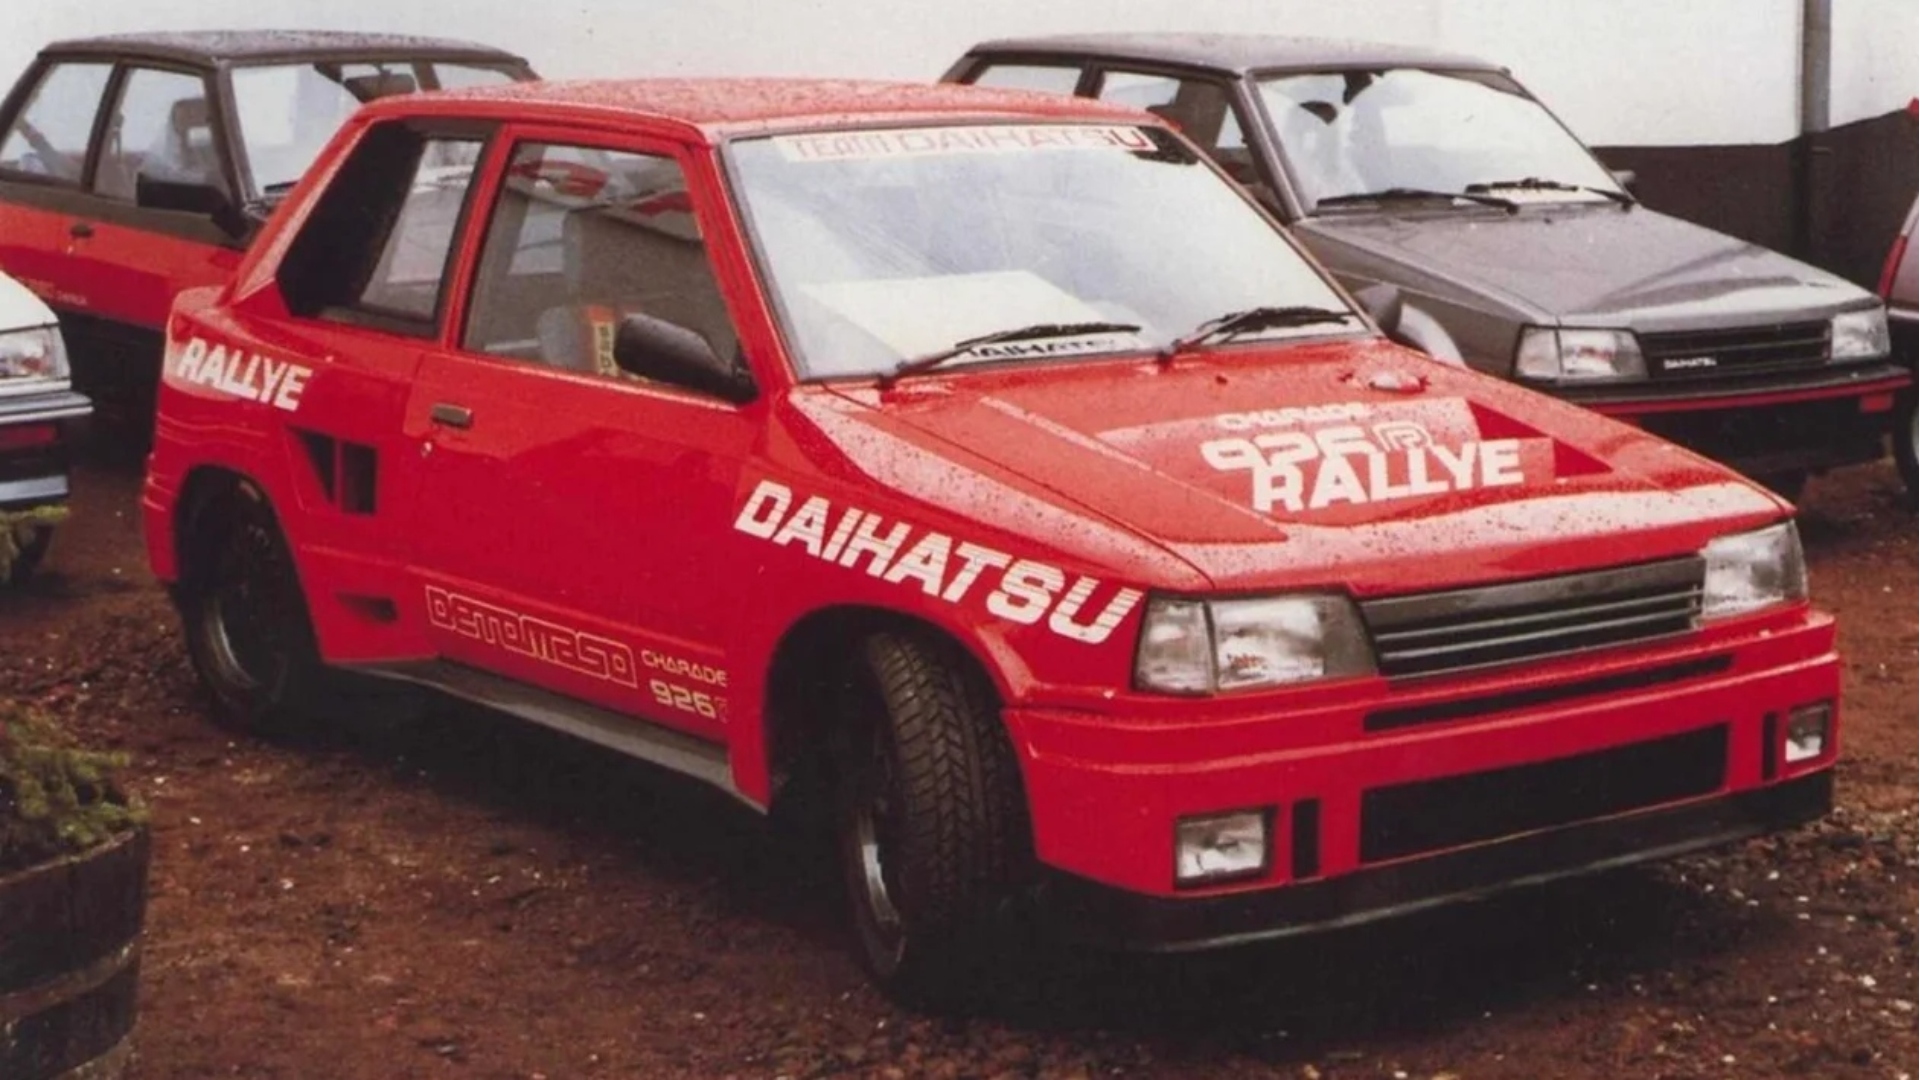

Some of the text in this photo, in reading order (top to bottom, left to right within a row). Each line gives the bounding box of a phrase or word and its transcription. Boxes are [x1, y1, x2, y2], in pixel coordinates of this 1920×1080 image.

[897, 127, 1147, 153] DAIHATSU
[176, 337, 313, 412] RALLYE
[1252, 439, 1525, 513] RALLYE
[733, 479, 1144, 645] DAIHATSU
[641, 650, 727, 688] CHARADE
